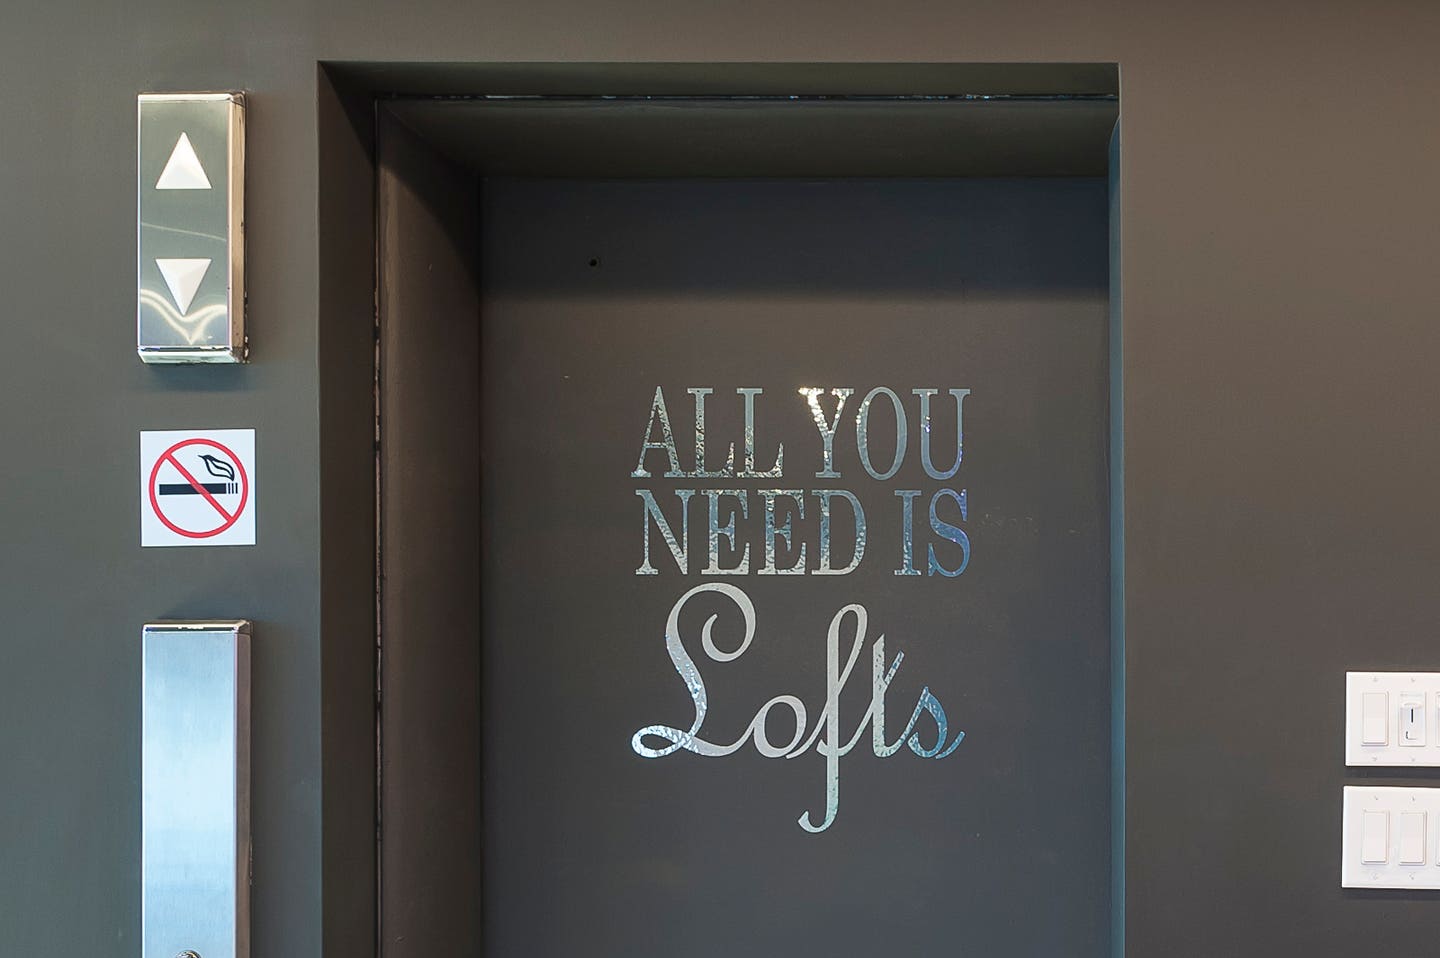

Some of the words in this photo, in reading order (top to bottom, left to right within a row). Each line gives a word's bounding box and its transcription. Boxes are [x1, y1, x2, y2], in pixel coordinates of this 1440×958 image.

[630, 385, 784, 479] ALL
[798, 386, 971, 481] YOU
[635, 488, 867, 576] NEED
[894, 487, 971, 578] IS
[630, 582, 966, 834] Lofts
